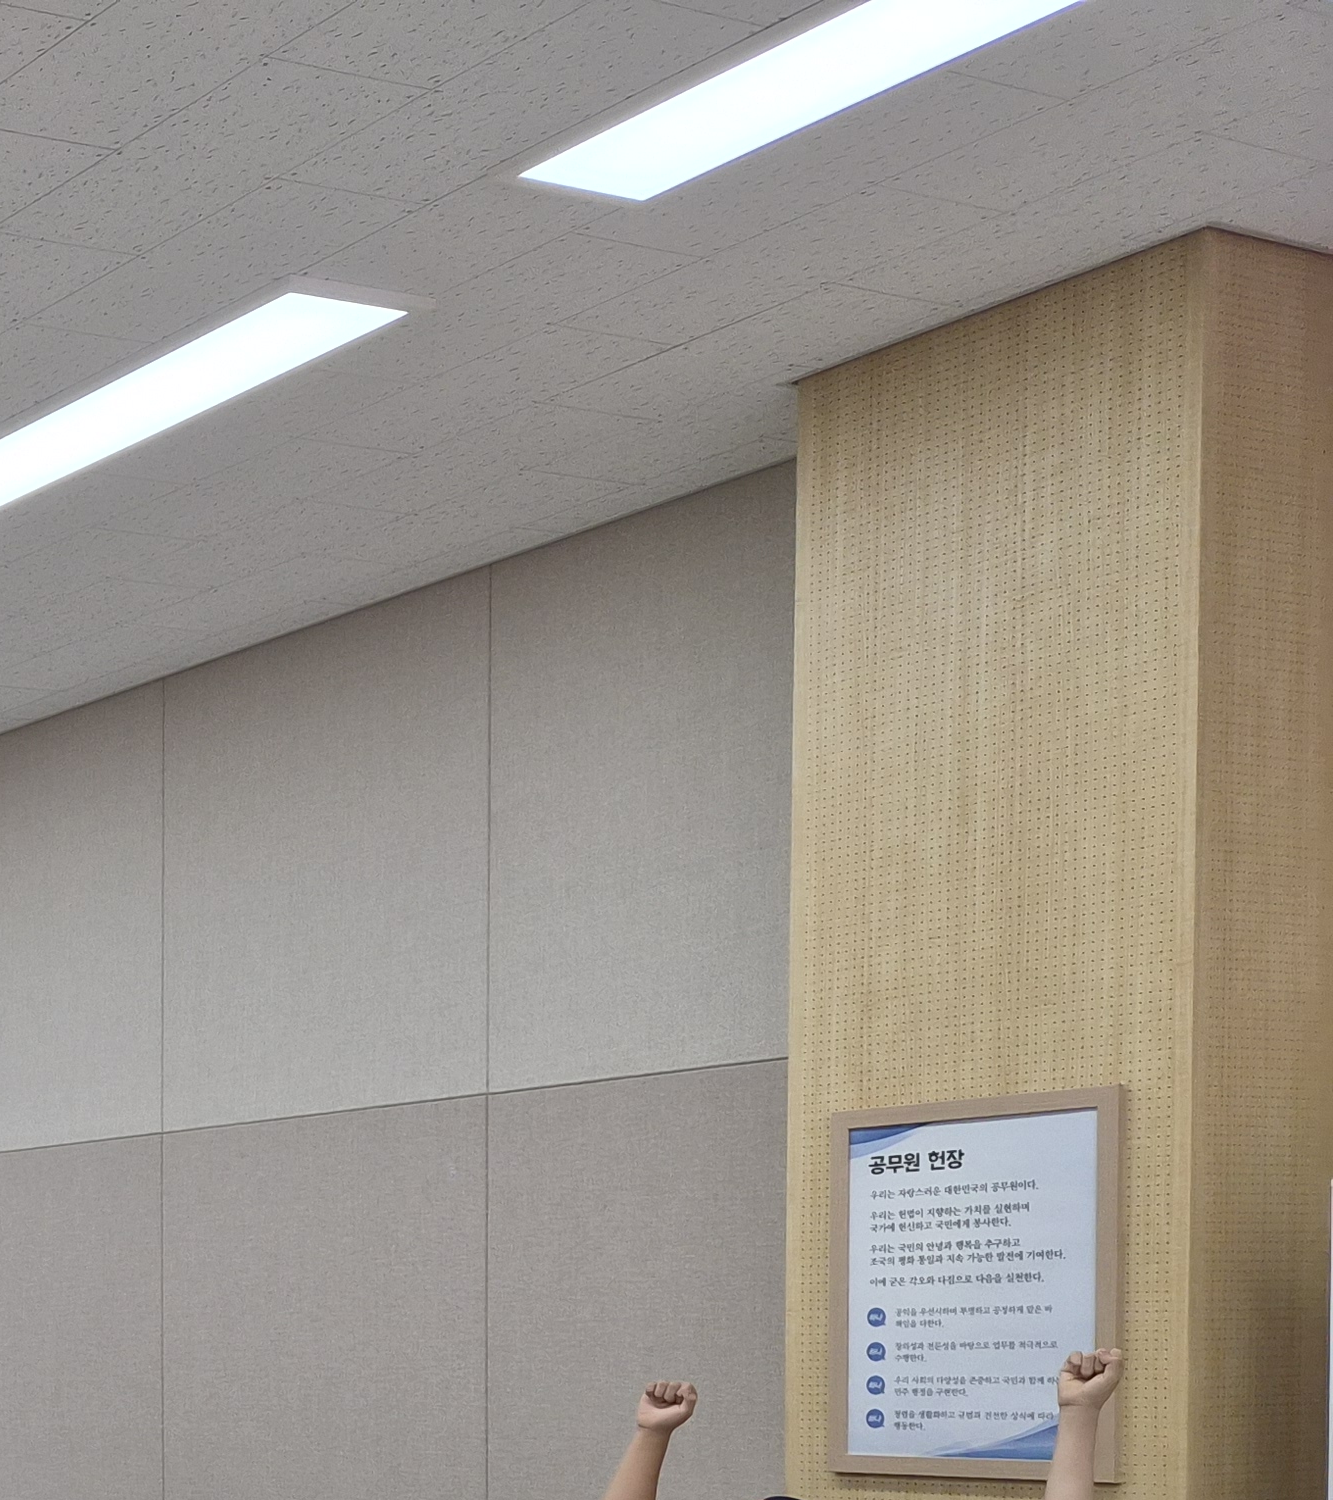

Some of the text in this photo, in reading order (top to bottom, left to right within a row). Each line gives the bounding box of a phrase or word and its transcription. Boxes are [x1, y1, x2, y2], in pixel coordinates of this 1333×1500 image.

[868, 1149, 965, 1175] 공무원 헌장
[870, 1179, 1039, 1200] 우리는 자랑스러운 대한민국의 공무원이다.
[870, 1202, 1030, 1220] 우리는 헌법이 지향하는 가치를 실현하며
[870, 1216, 1012, 1233] 국가에 헌신하고 국민에게 봉사한다.
[870, 1238, 1021, 1254] 우리는 국민의 안녕과 행복을 추구하고
[967, 1252, 993, 1262] 가능한
[996, 1250, 1023, 1261] 발전에
[1026, 1249, 1066, 1260] 기여한다.
[870, 1277, 887, 1287] 이에
[938, 1274, 973, 1285] 다짐으로
[976, 1273, 1002, 1283] 다음을
[1006, 1271, 1045, 1283] 실천한다.
